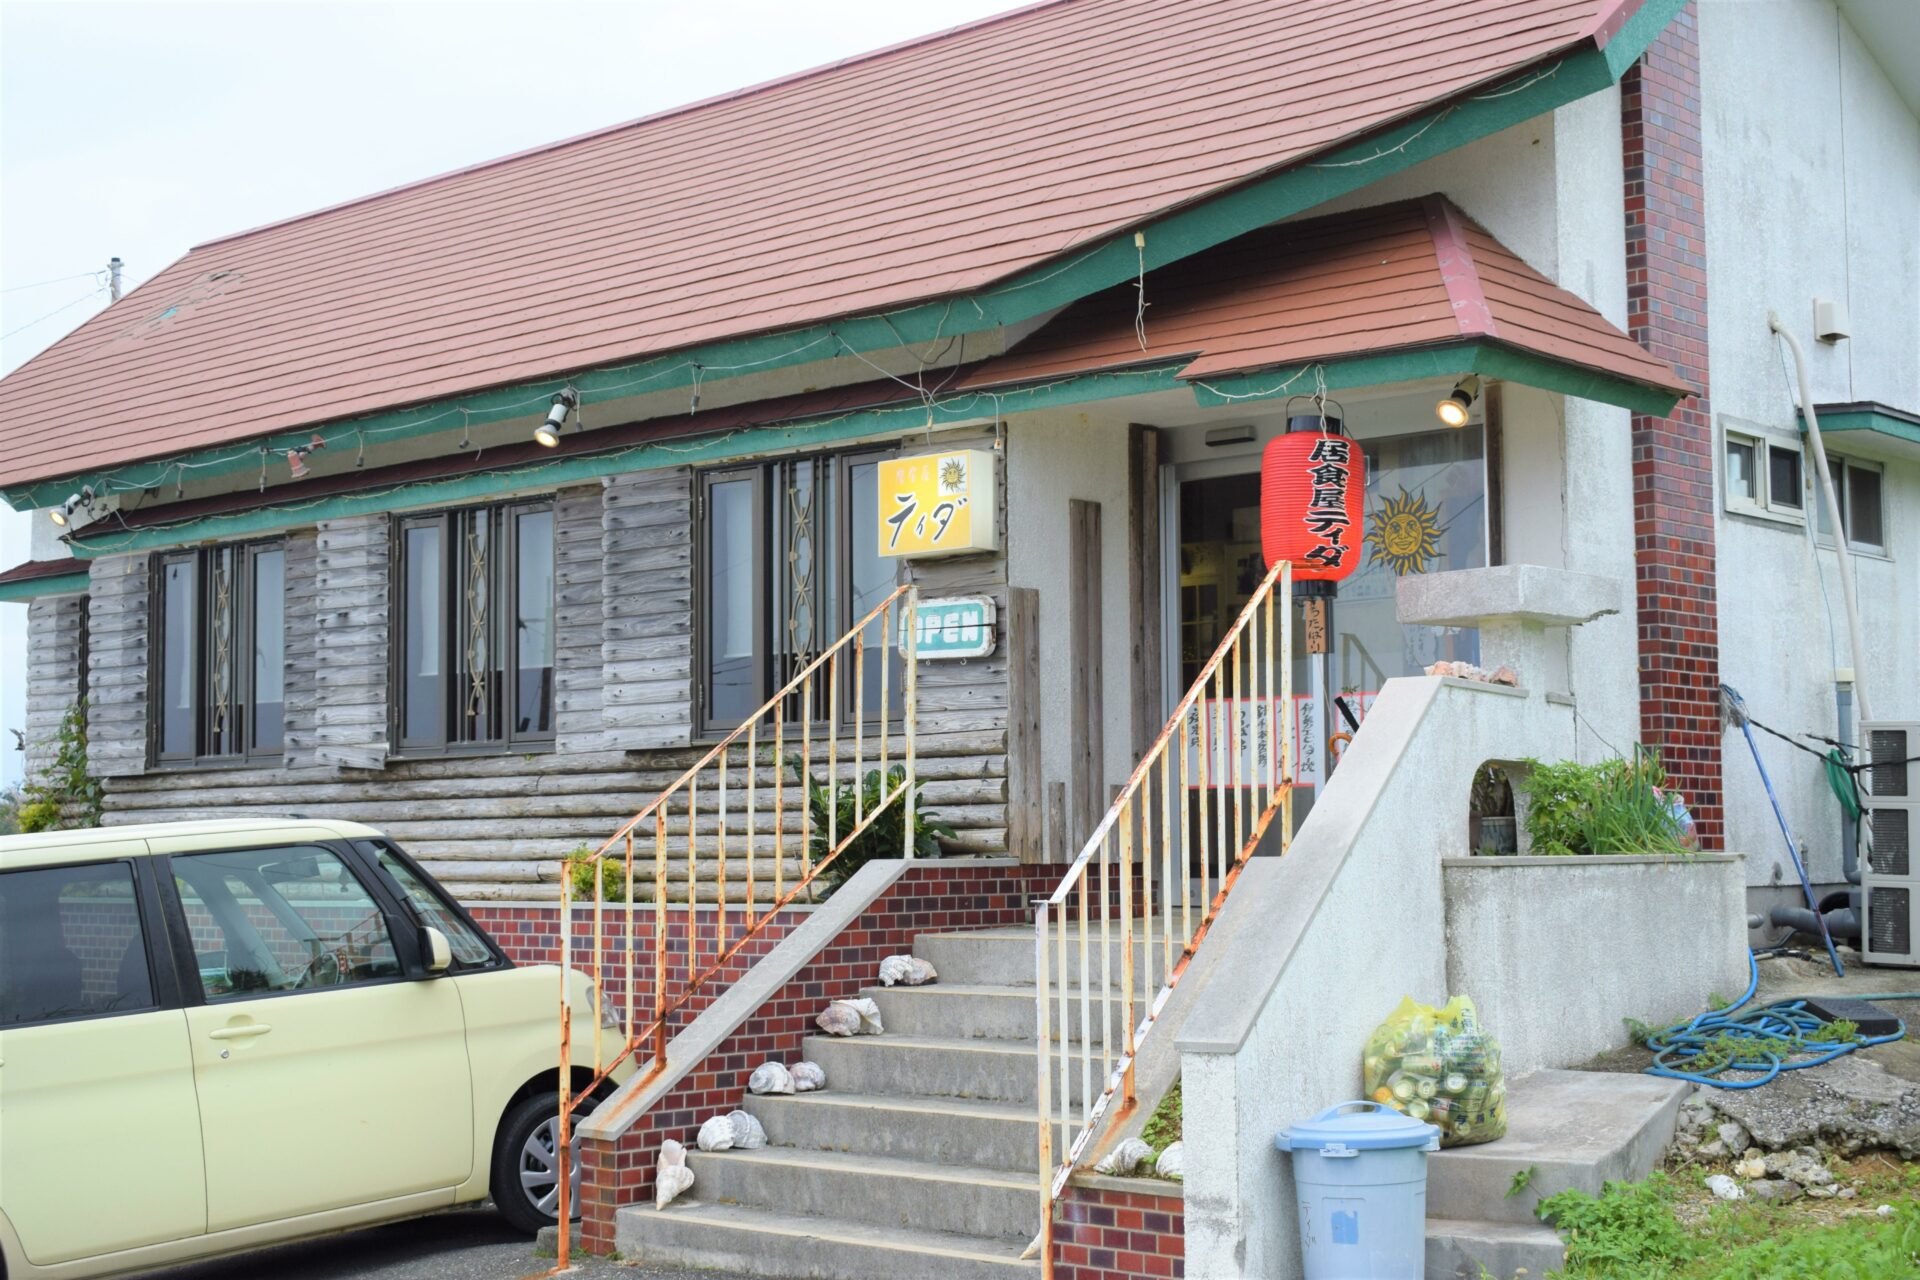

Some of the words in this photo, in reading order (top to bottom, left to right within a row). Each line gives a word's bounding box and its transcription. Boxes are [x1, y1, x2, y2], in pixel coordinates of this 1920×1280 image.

[1303, 438, 1351, 568] 居食屋ティダ
